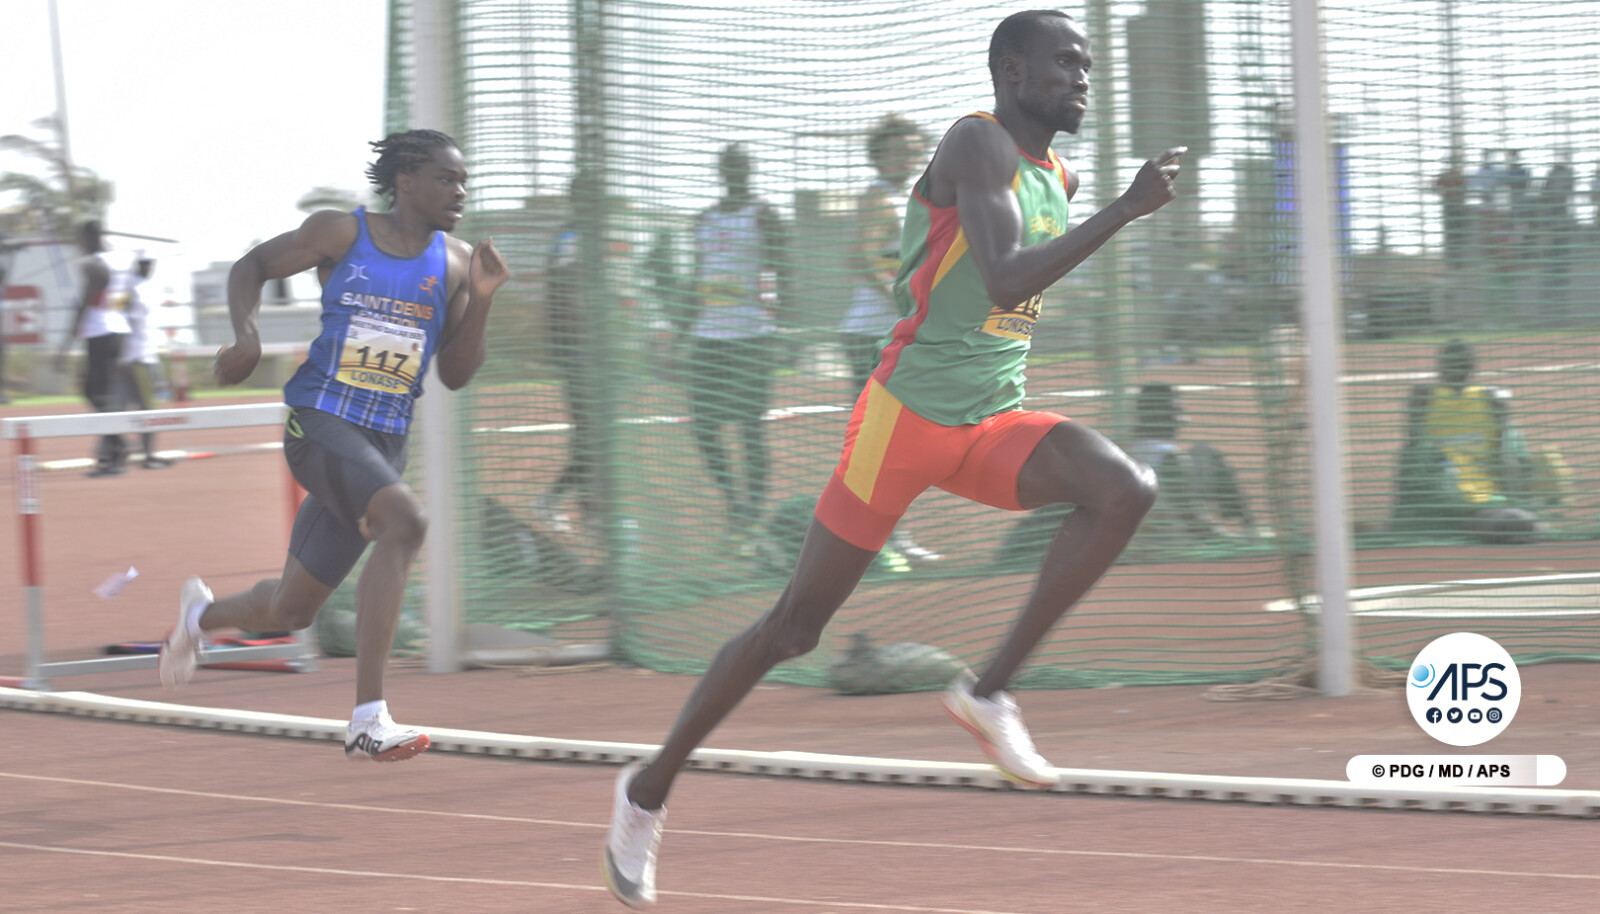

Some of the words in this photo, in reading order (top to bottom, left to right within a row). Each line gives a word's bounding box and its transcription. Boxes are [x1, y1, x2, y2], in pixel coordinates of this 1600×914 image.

[340, 292, 391, 310] SAINT
[357, 346, 409, 374] 117
[351, 370, 398, 388] LONASE
